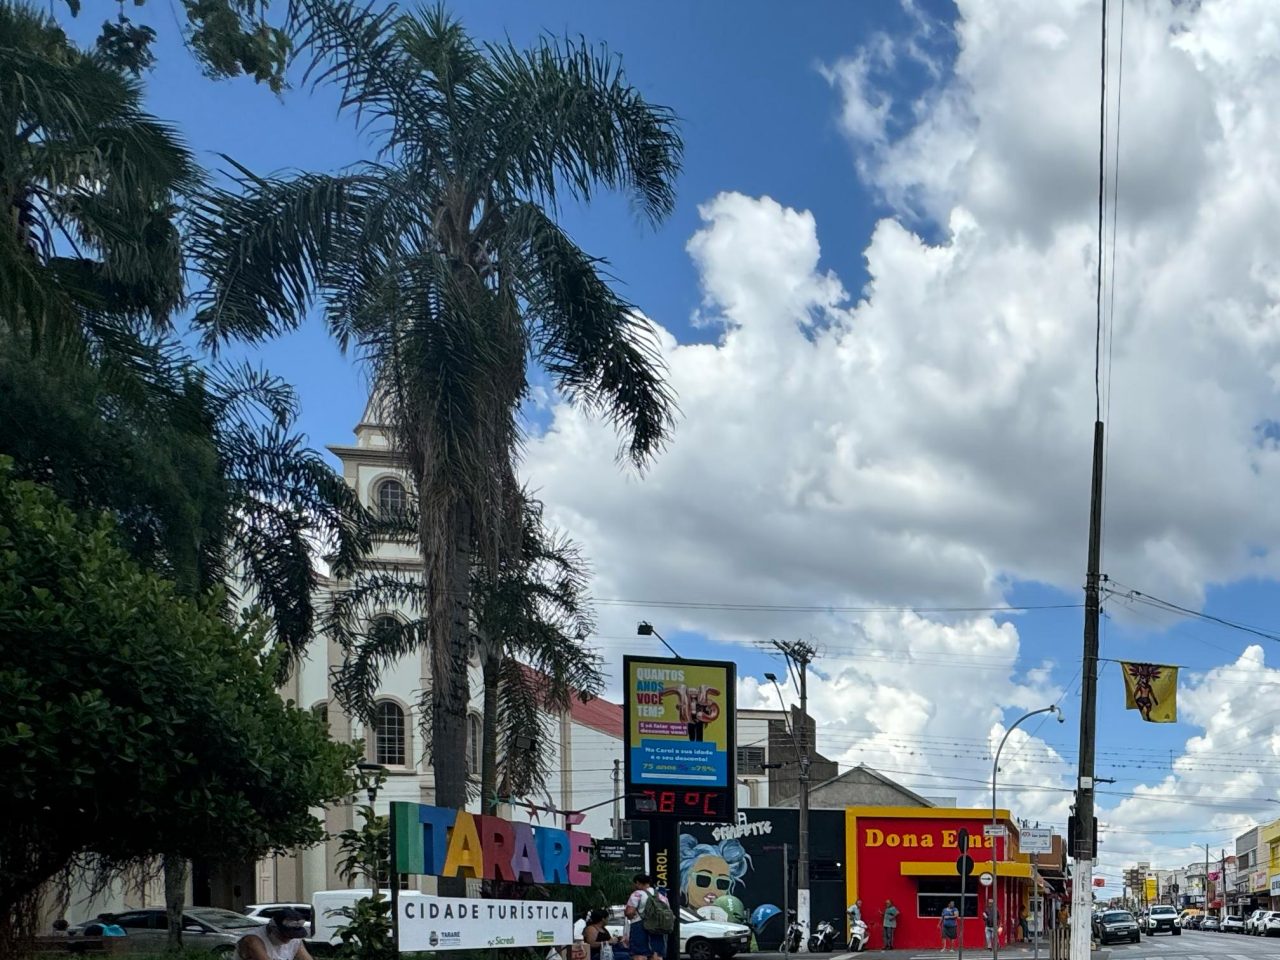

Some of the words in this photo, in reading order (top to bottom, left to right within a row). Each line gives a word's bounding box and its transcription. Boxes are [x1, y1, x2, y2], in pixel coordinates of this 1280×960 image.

[637, 668, 685, 681] QUANTOS
[637, 681, 664, 692] ANOS
[637, 706, 665, 718] TEM?
[396, 802, 592, 886] ITARARÉ
[865, 829, 934, 847] Dona
[656, 848, 668, 888] CAROL
[405, 902, 479, 919] CIDADE
[487, 902, 569, 920] TURÍSTICA
[495, 936, 515, 945] Sicredi
